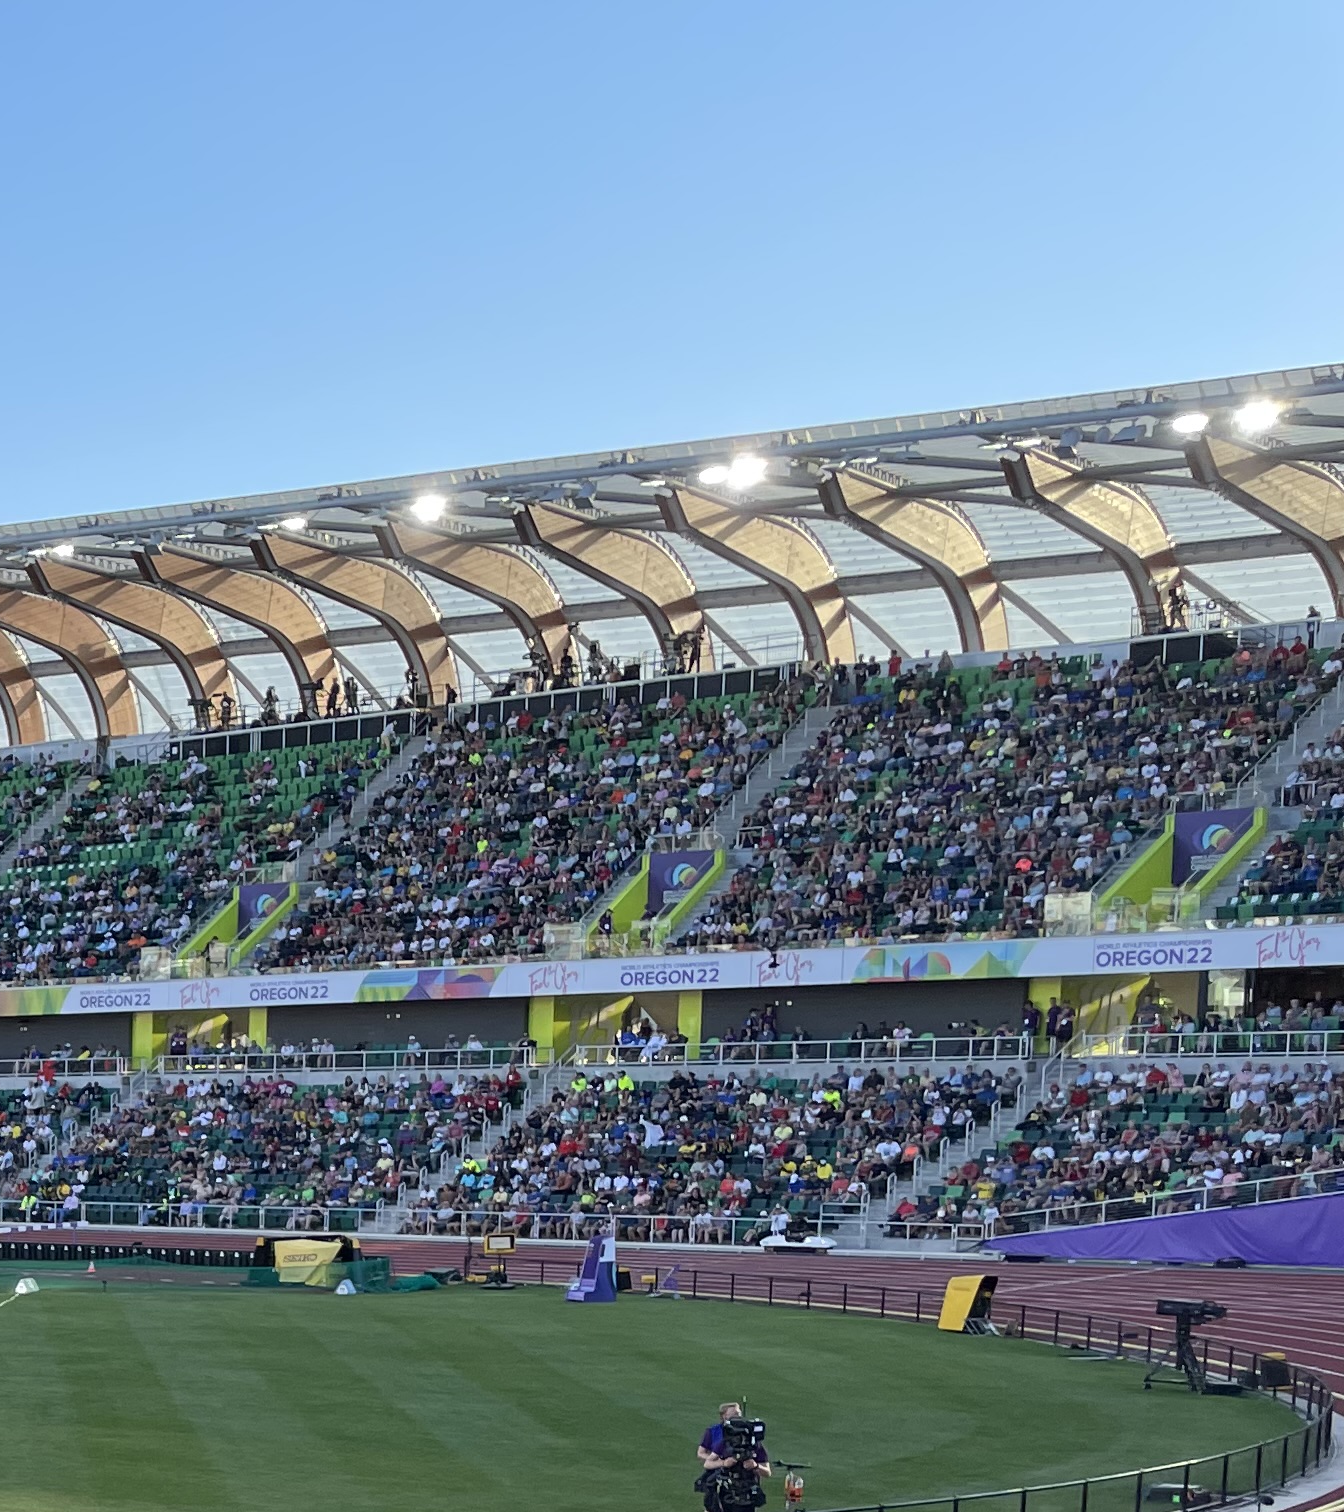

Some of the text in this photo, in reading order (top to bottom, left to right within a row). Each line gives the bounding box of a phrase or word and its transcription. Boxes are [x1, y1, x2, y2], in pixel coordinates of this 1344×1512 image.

[1096, 947, 1212, 968] OREGON 22
[621, 967, 720, 986] OREGON 22
[80, 993, 151, 1008] OREGON 22
[250, 985, 329, 1001] OREGON 22
